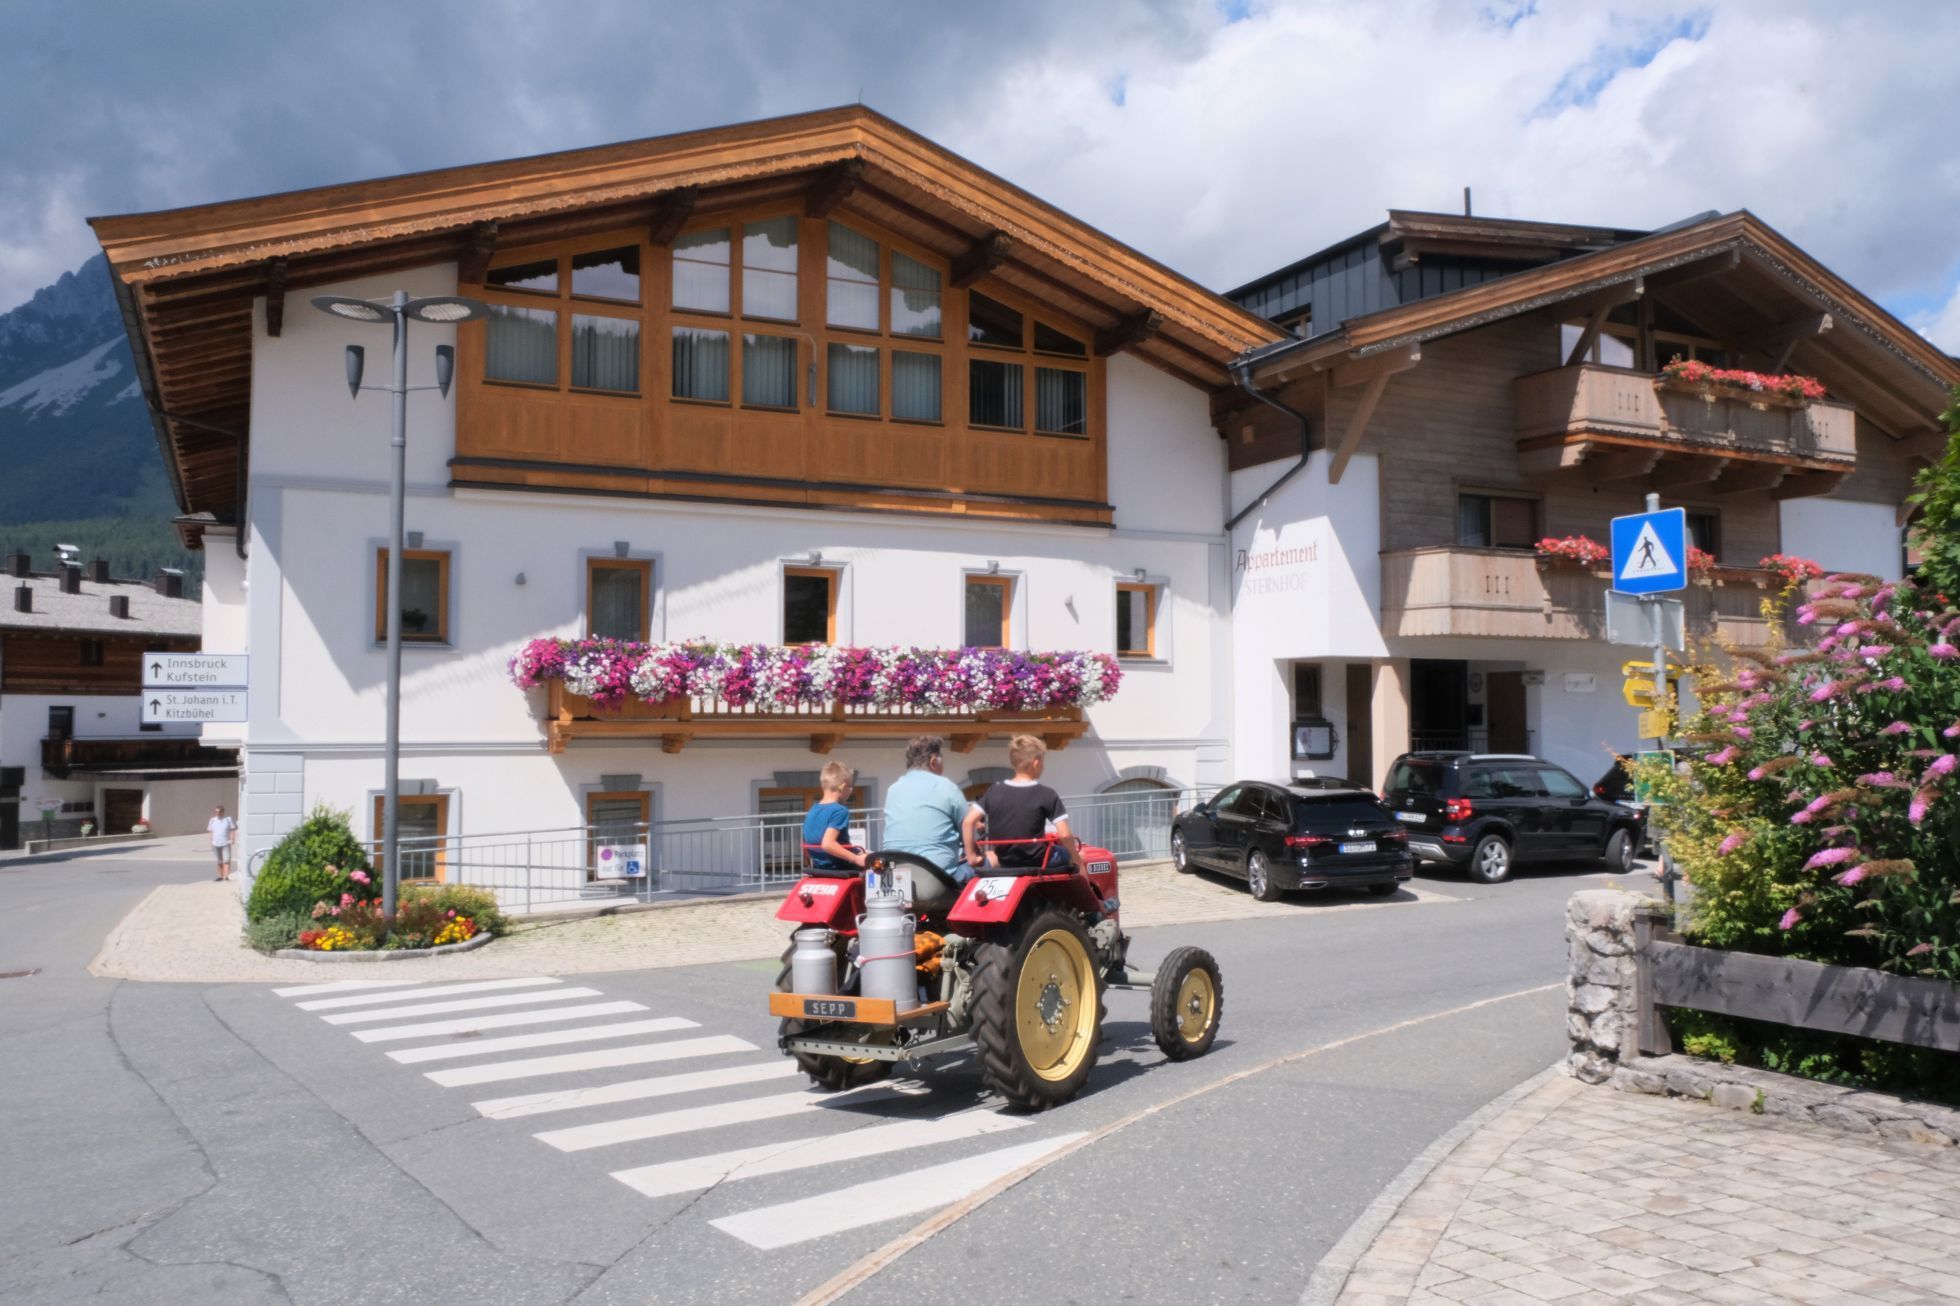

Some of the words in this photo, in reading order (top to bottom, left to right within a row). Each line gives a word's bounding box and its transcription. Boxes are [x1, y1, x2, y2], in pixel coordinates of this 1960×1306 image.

[1236, 539, 1318, 573] Appartement
[1246, 573, 1308, 595] STERNHOF
[167, 658, 227, 669] Innsbruck
[167, 672, 217, 682] Kufstein
[166, 695, 180, 705] St.
[181, 694, 219, 705] Johann
[166, 708, 214, 719] Kitzbühel
[798, 884, 839, 896] STEYR
[812, 1001, 845, 1015] SEPP
